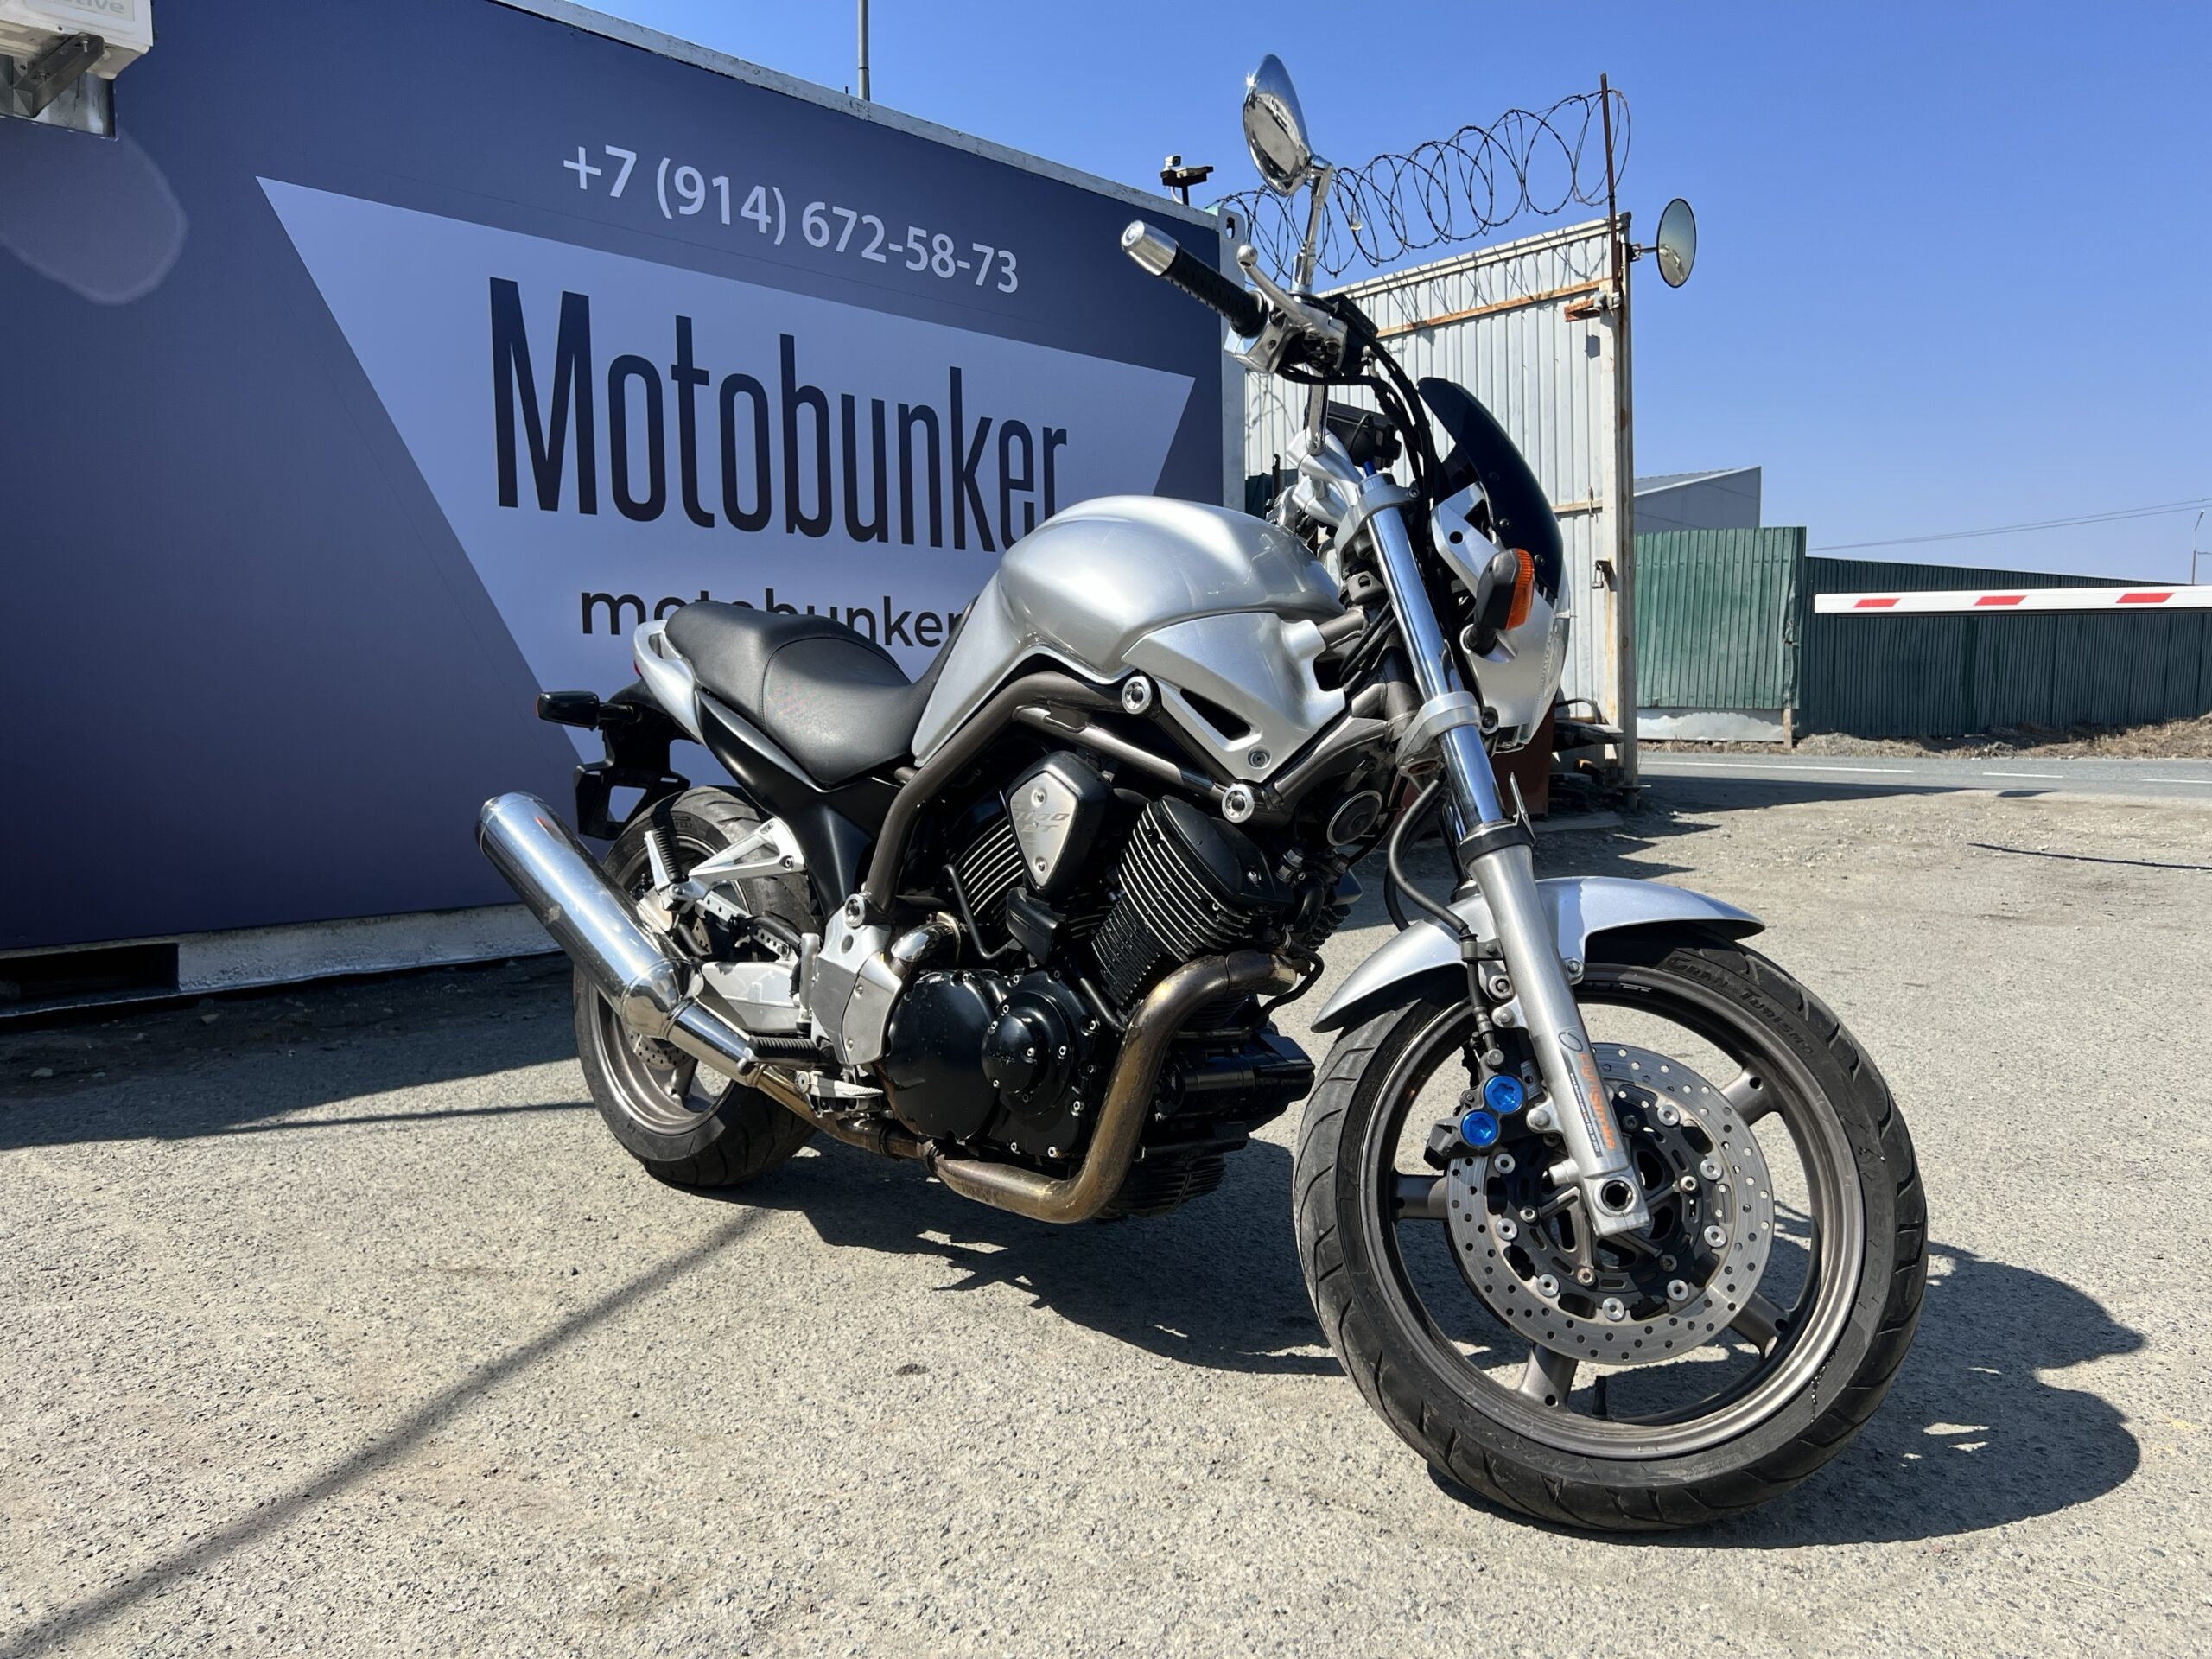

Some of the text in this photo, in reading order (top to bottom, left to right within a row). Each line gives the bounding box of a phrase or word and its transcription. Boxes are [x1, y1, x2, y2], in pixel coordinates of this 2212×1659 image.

[563, 144, 1019, 294] +7 (914) 672-58-73
[490, 276, 1067, 553] Motobunker
